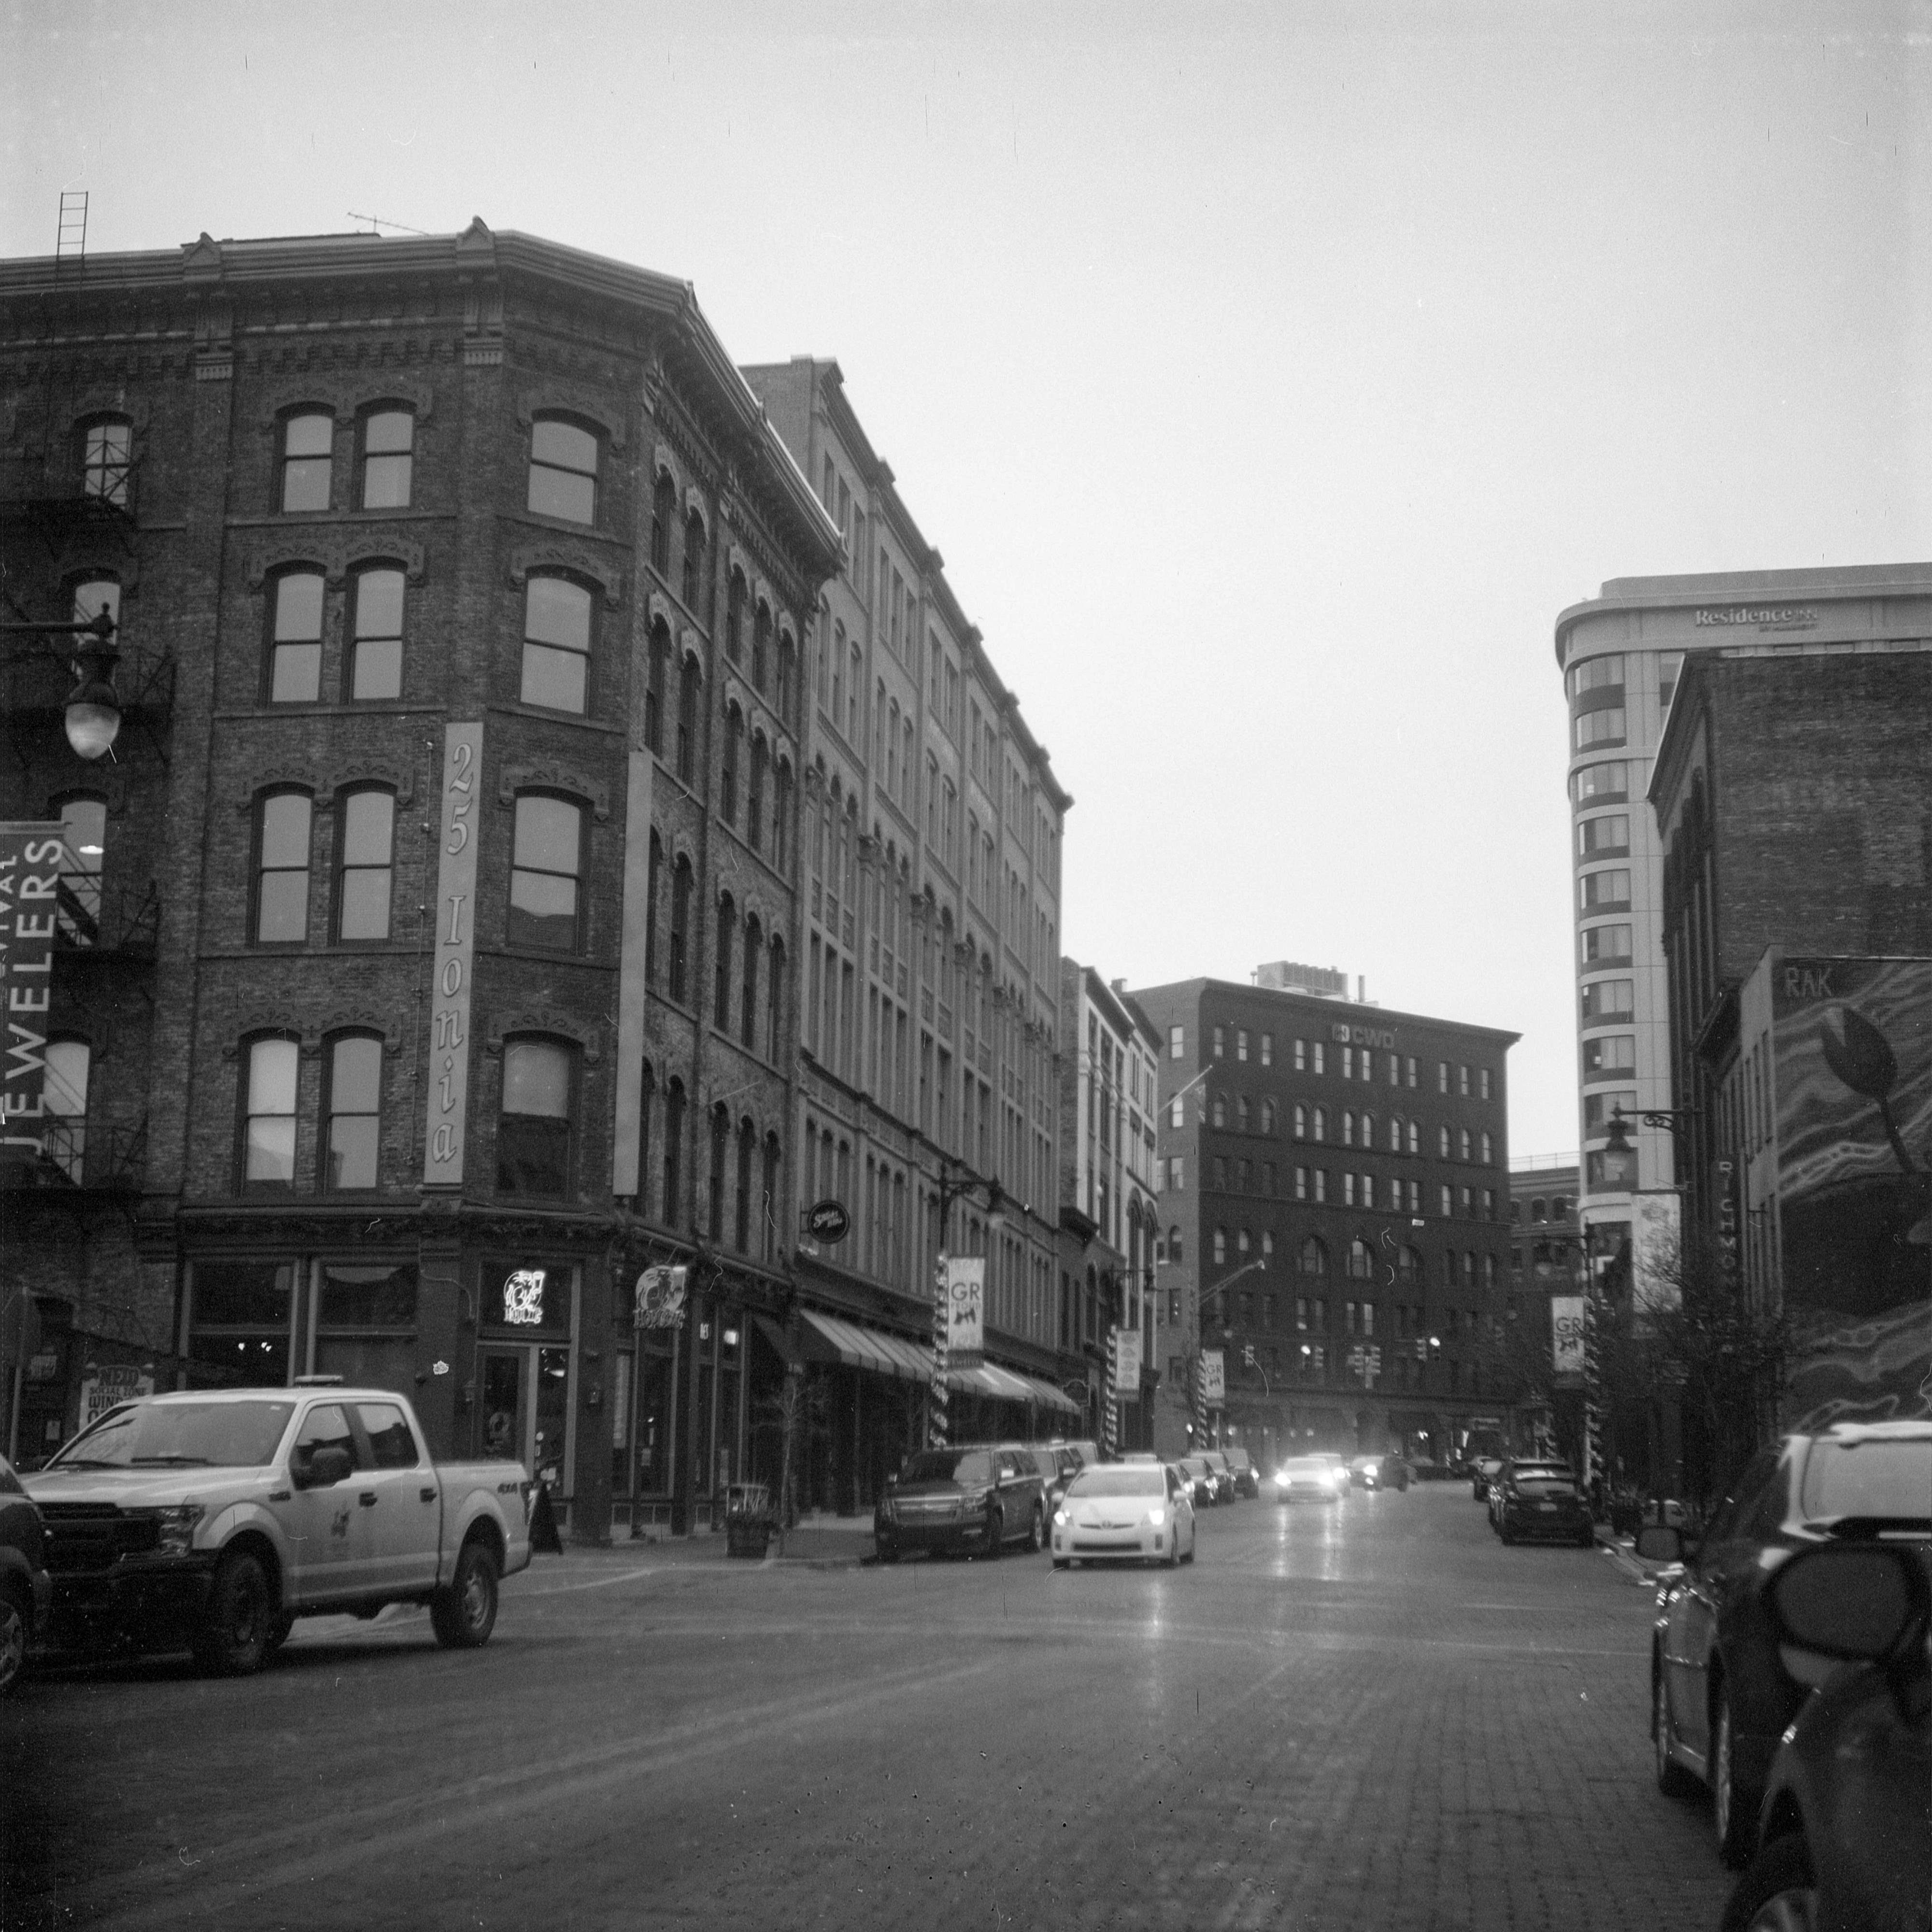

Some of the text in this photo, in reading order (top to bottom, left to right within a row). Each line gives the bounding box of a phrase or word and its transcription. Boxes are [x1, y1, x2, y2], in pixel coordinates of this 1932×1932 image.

[1695, 608, 1792, 626] Residence
[432, 743, 474, 1163] 25 Ionia
[0, 839, 64, 1156] JEWELERS
[951, 1281, 980, 1301] GR
[1556, 1317, 1583, 1333] GR
[1207, 1364, 1222, 1375] GR
